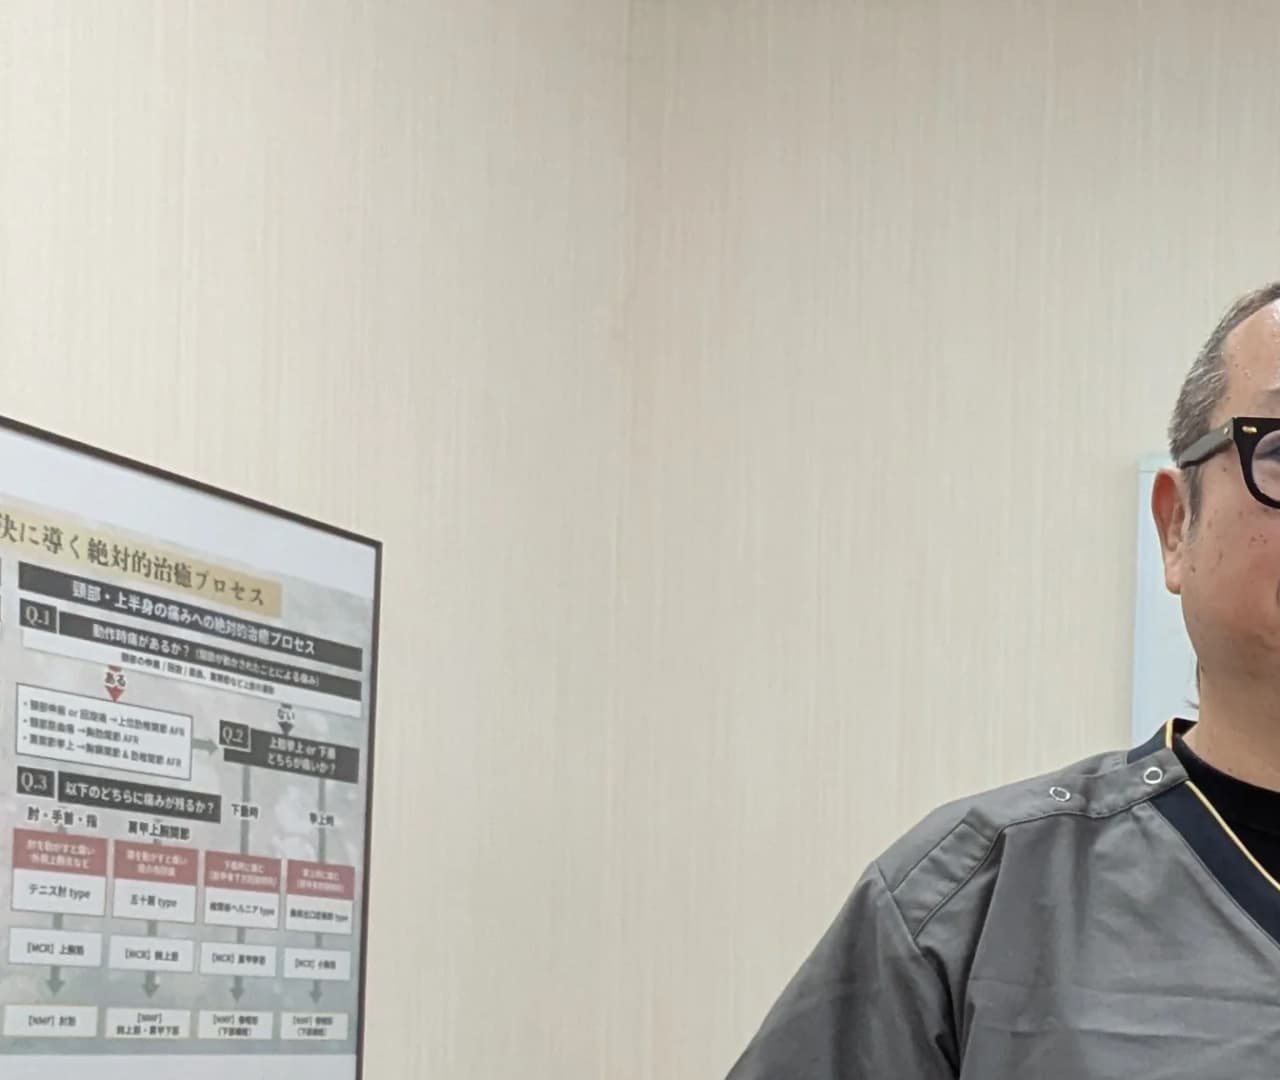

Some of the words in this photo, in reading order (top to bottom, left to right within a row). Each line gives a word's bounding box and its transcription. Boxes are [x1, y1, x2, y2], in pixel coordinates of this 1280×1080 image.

[25, 606, 50, 626] Q.1
[104, 671, 127, 687] ある
[221, 726, 244, 744] Q.2
[20, 772, 48, 791] Q.3
[69, 886, 91, 900] type
